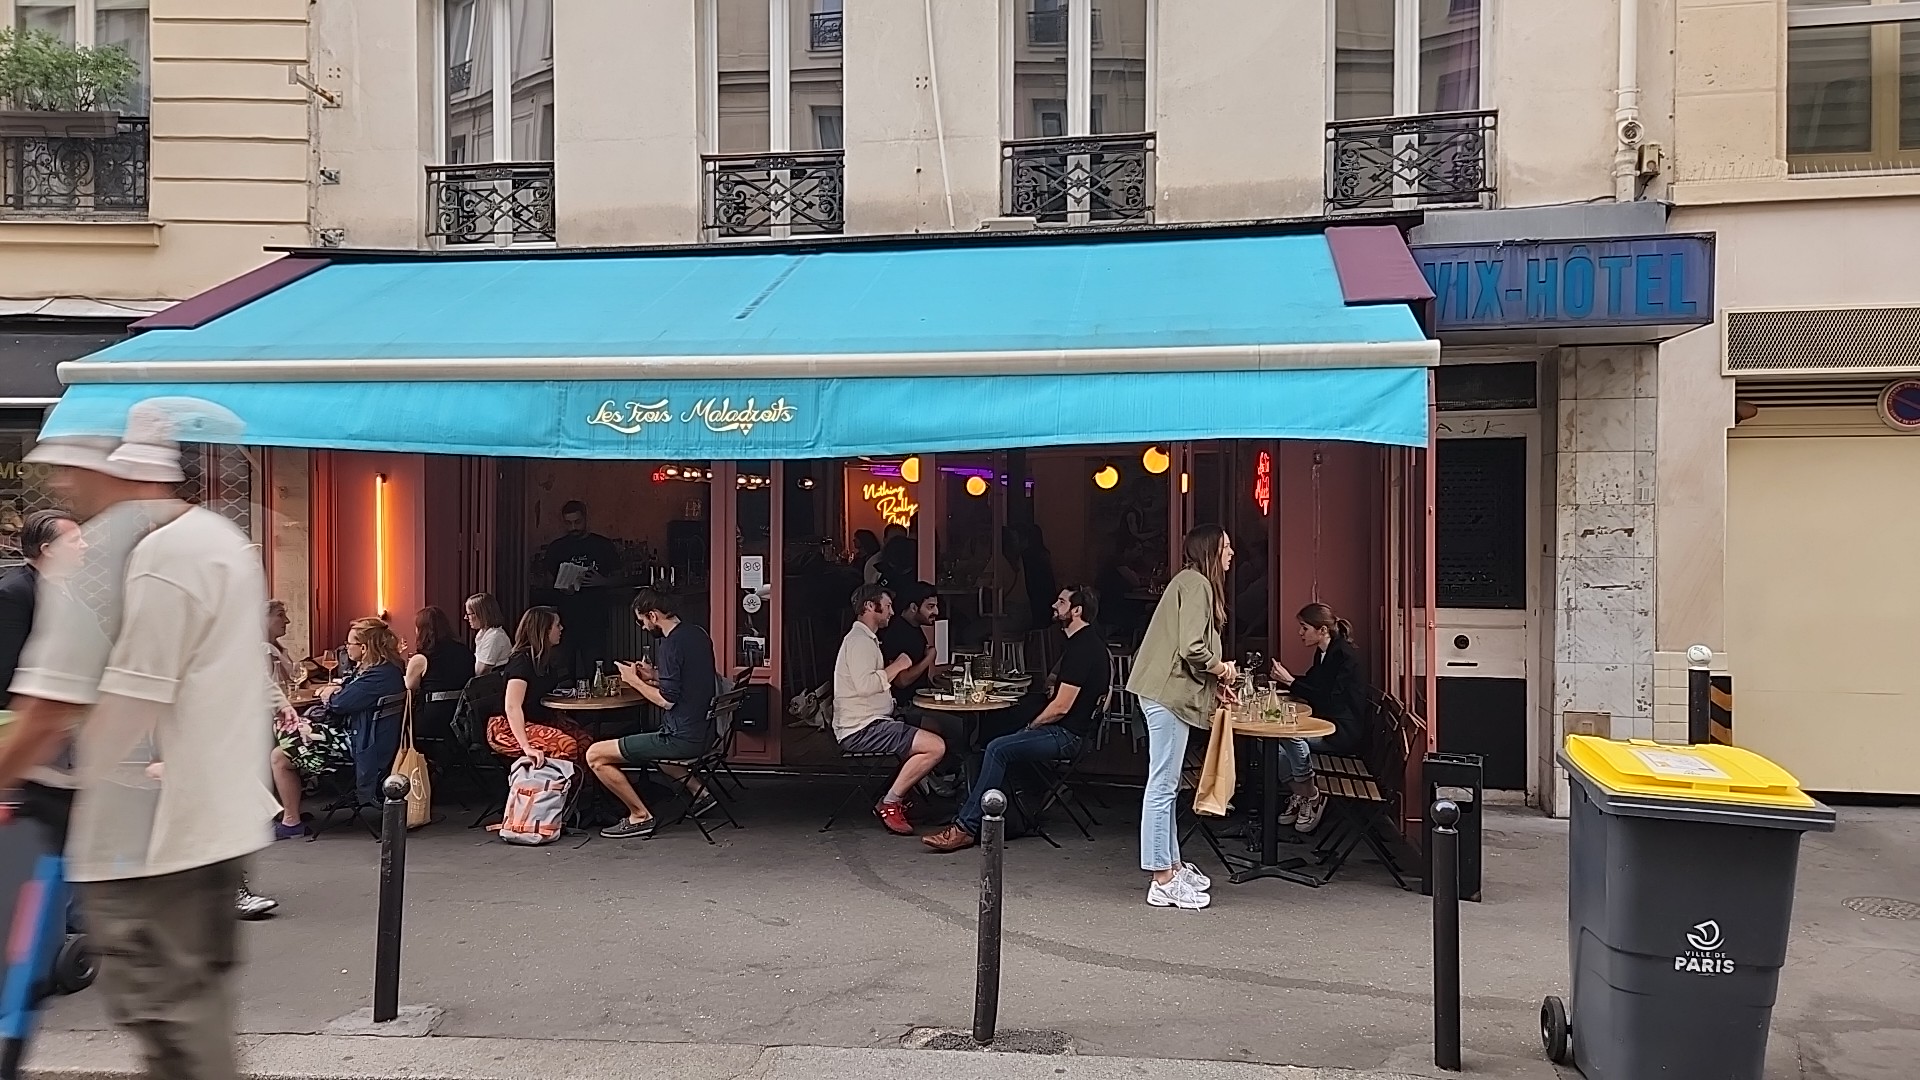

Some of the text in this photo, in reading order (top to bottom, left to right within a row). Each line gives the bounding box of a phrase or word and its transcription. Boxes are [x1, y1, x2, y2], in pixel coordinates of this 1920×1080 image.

[586, 397, 798, 433] Les Trois Maladroits
[863, 481, 905, 500] Nothing
[877, 497, 918, 519] Really
[1685, 950, 1711, 958] VILLE
[1674, 956, 1735, 974] PARIS
